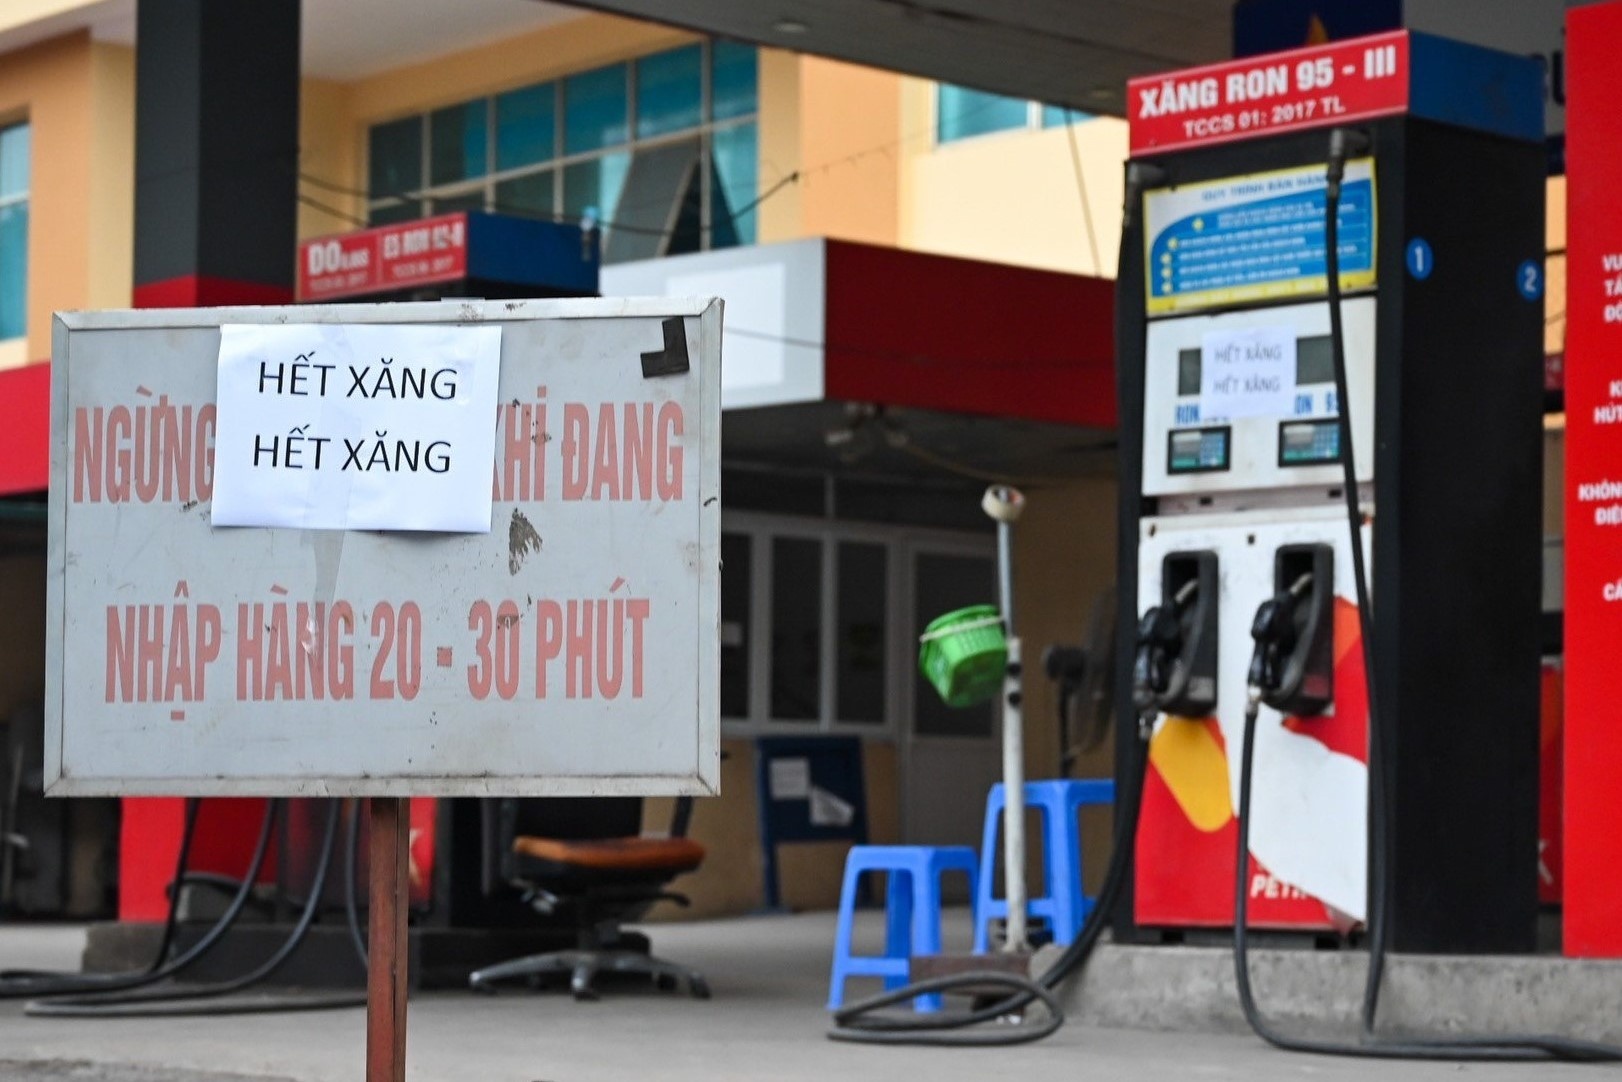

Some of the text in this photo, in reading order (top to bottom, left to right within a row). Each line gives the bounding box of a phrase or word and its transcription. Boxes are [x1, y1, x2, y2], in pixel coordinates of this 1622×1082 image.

[1139, 77, 1219, 119] XĂNG
[1226, 65, 1289, 103] RON
[1296, 57, 1334, 90] 95
[1364, 45, 1397, 80] III
[1184, 113, 1235, 138] TCCS
[1272, 97, 1316, 123] 2017
[1322, 96, 1346, 115] TL
[308, 239, 342, 276] DO
[1414, 245, 1425, 272] 1
[1524, 265, 1537, 292] 2
[258, 351, 458, 400] HẾT XĂNG
[73, 385, 217, 503] NGỪNG
[561, 402, 685, 502] ĐANG
[253, 424, 452, 474] HẾT XĂNG
[1578, 478, 1622, 501] KHÔN
[104, 580, 222, 721] NHẬP
[236, 583, 355, 702] HÀNG
[370, 601, 422, 700] 20
[468, 600, 521, 700] 30
[535, 577, 651, 699] PHÚT
